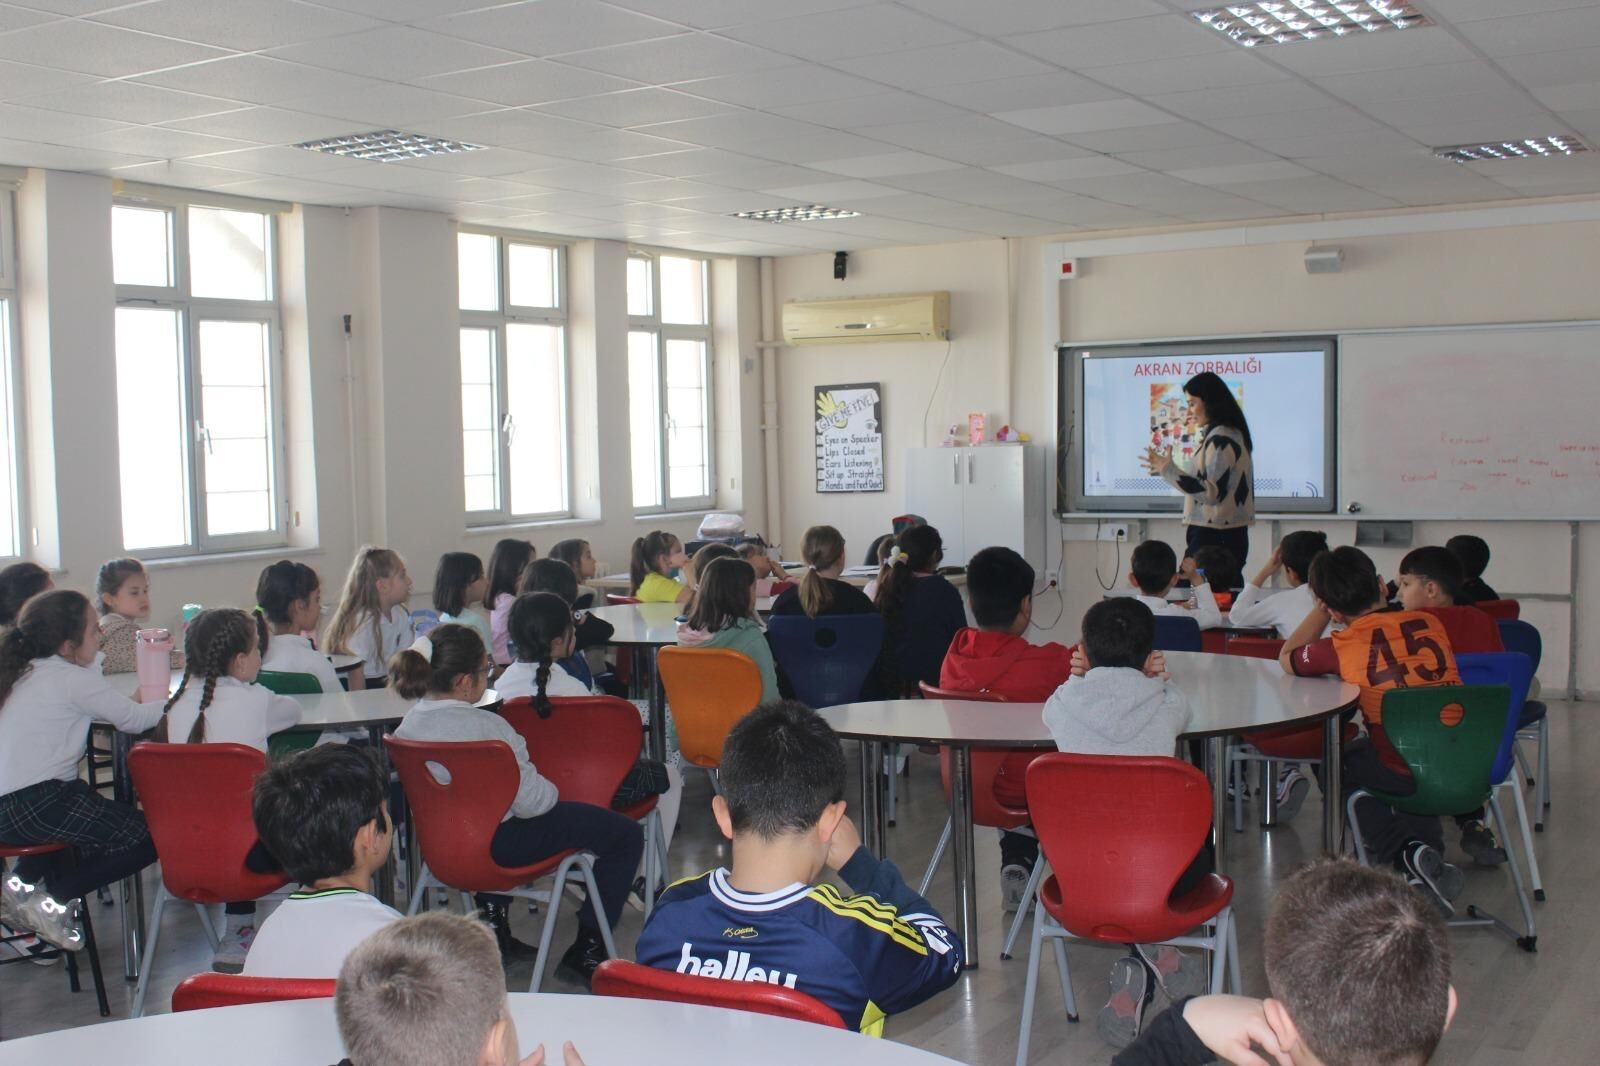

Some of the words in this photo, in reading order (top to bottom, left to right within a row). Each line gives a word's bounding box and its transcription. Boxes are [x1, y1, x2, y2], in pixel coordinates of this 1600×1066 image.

[1134, 362, 1182, 377] AKRAN
[1186, 357, 1262, 375] ZORBALIĞI
[820, 413, 840, 430] GIVE
[840, 405, 853, 419] ME
[825, 435, 839, 446] Eyes
[851, 434, 879, 446] Speaker
[825, 447, 839, 458] Lips
[842, 446, 865, 456] Closed
[825, 458, 840, 468] Ears
[844, 458, 873, 468] Listening
[825, 469, 835, 479] Sit
[836, 472, 844, 480] up
[847, 469, 874, 479] Straight
[825, 480, 844, 489] Hands
[845, 480, 856, 489] and
[1366, 618, 1448, 688] 45
